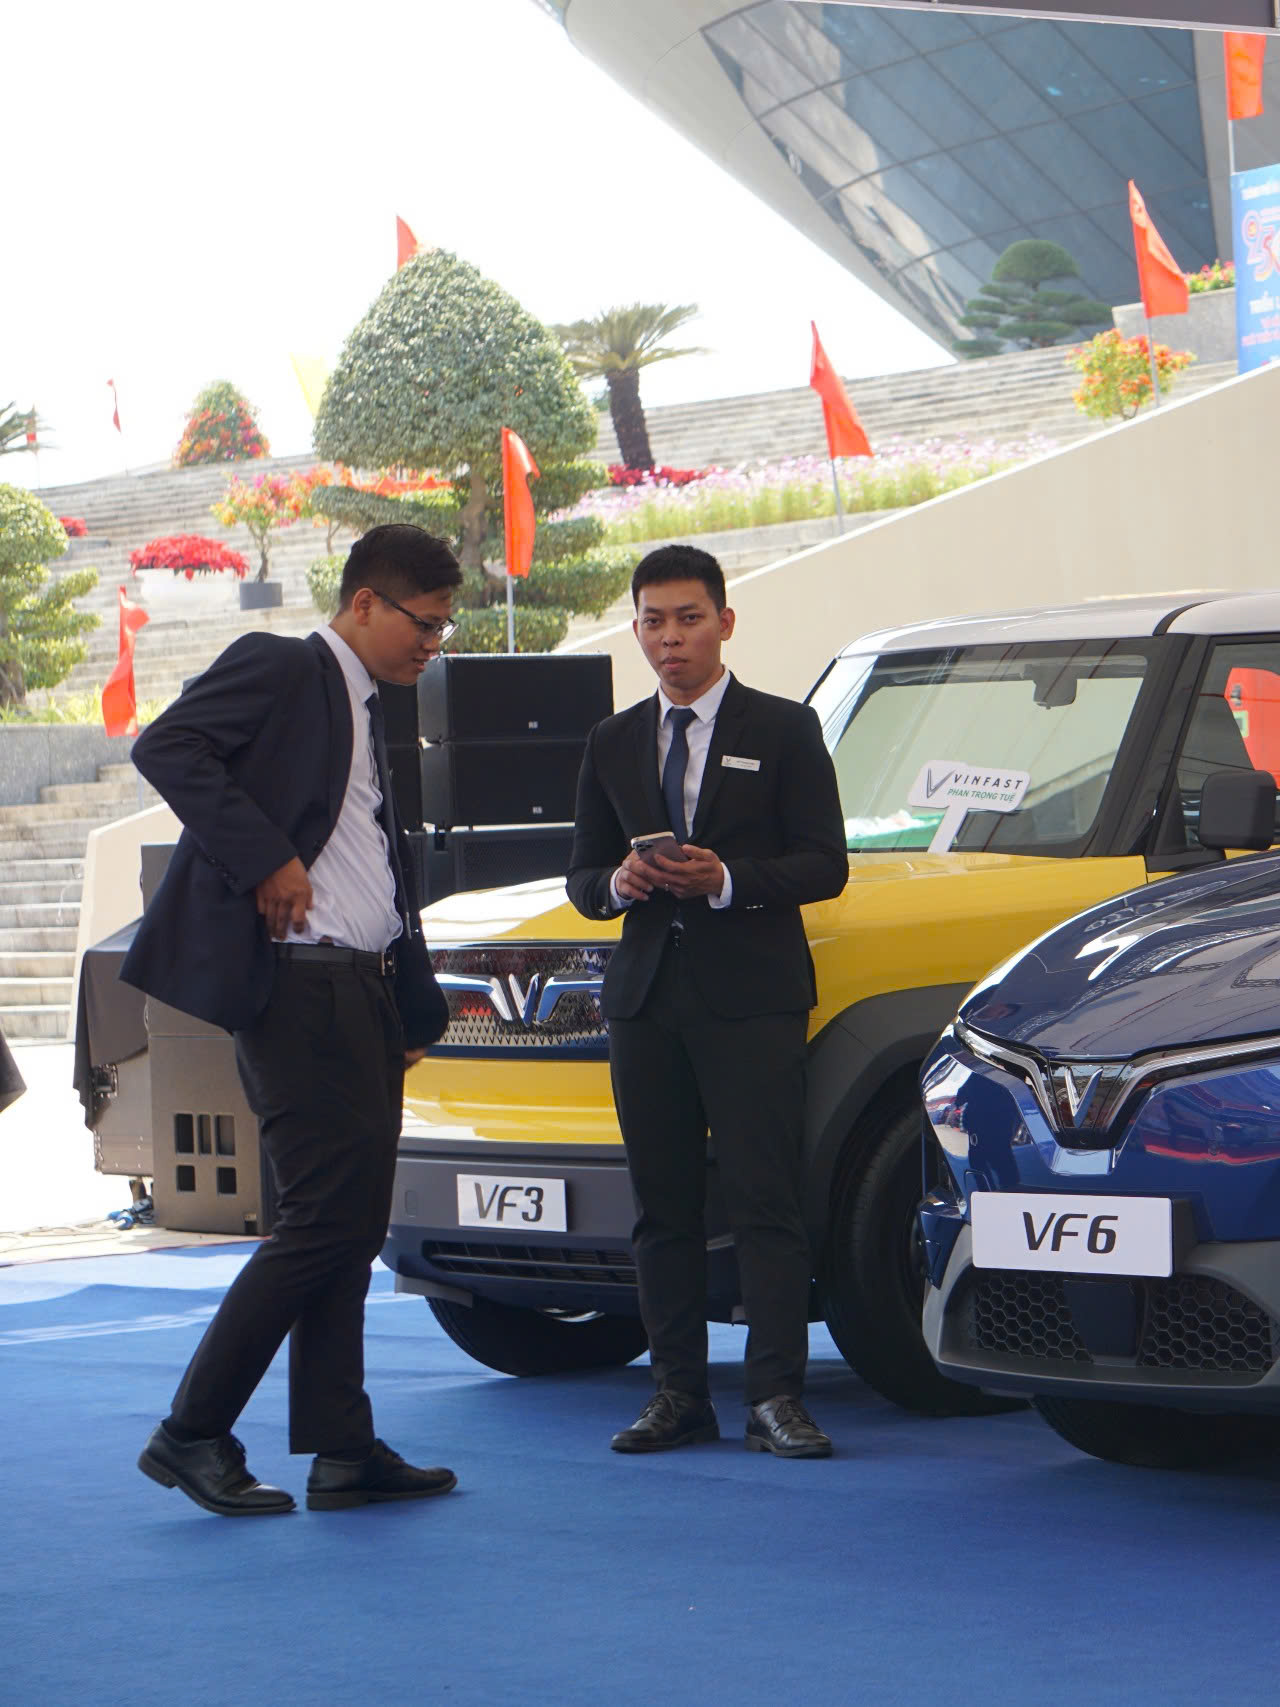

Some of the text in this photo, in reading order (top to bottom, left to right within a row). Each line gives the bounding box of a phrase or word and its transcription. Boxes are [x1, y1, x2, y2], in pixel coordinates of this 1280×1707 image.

[947, 788, 970, 798] PHAN
[954, 774, 1024, 790] VINFAST
[474, 1181, 545, 1223] VF3
[1022, 1211, 1119, 1254] VF6
